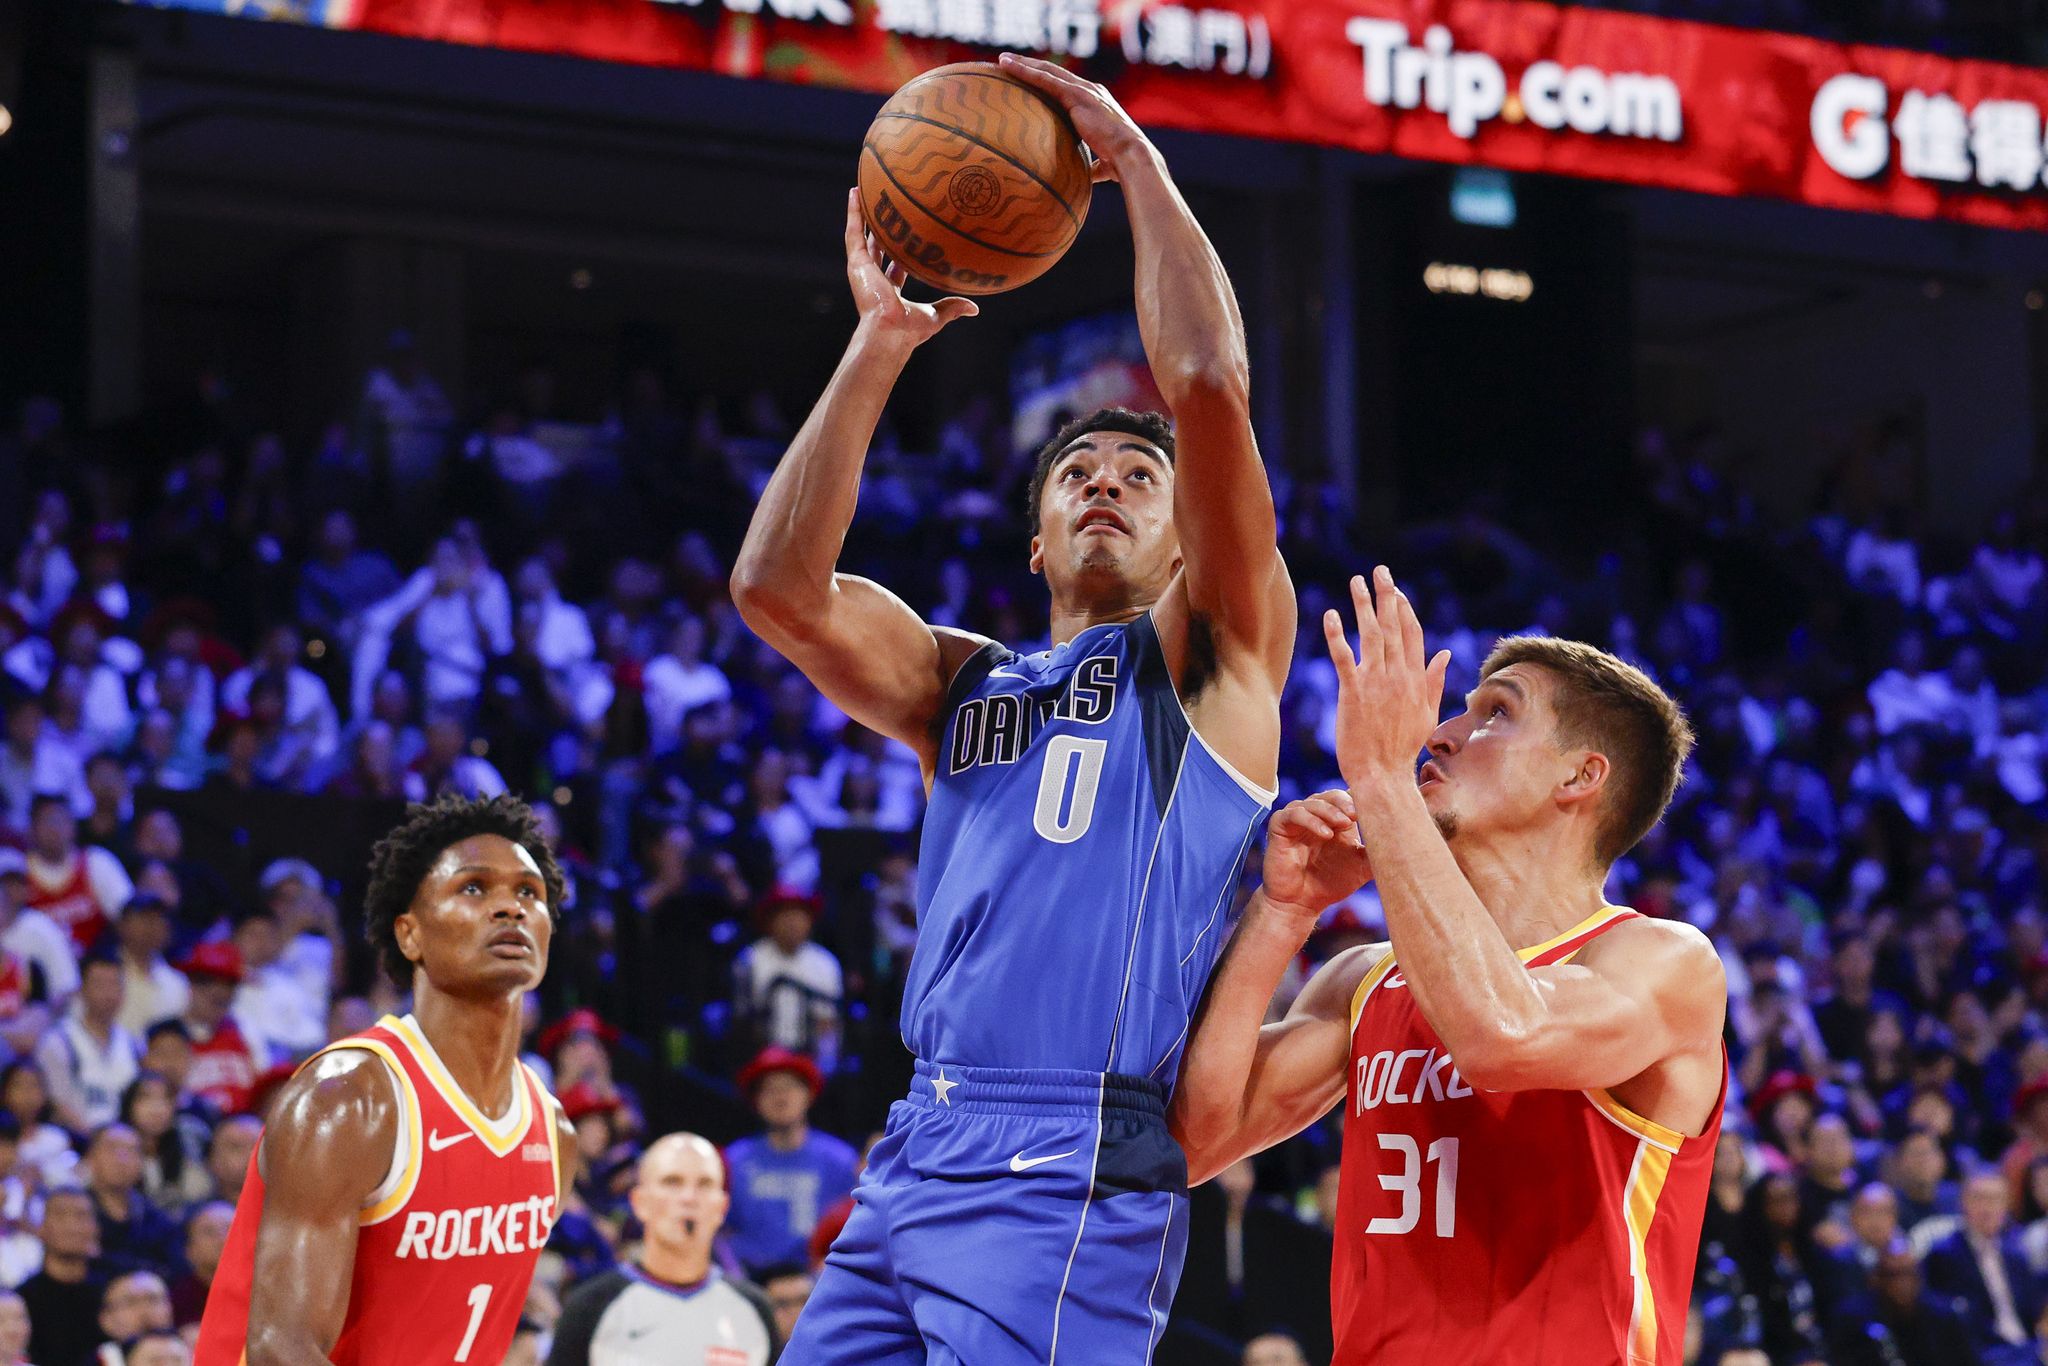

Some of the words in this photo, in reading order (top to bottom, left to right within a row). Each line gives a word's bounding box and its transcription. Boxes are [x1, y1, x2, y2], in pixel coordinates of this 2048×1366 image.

[1346, 16, 1683, 141] Trip.com
[1810, 72, 1889, 180] G
[1893, 88, 2048, 192] 佳得
[874, 188, 1009, 287] Wilson
[1032, 734, 1108, 844] 0
[395, 1195, 555, 1261] ROCKETS
[1365, 1133, 1459, 1238] 31
[454, 1283, 493, 1363] 1
